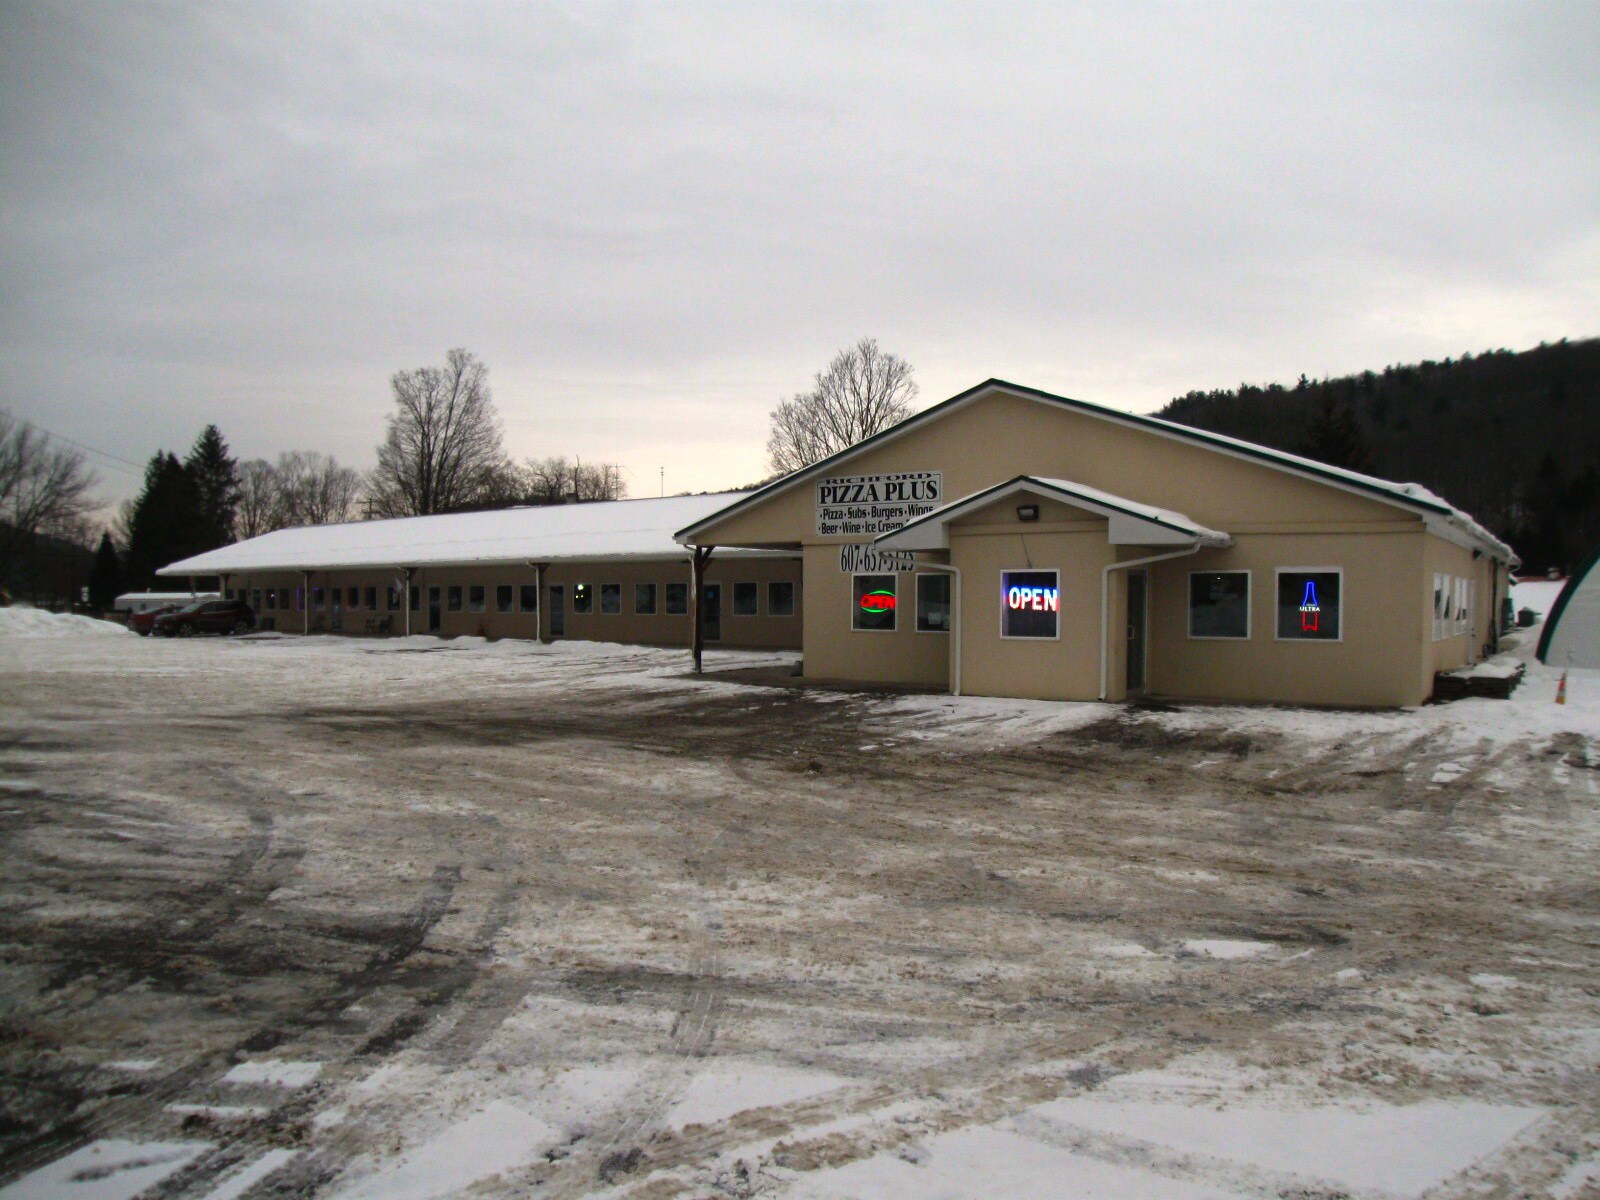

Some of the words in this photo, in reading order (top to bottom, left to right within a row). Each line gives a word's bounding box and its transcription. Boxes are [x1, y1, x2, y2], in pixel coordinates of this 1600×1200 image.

[825, 473, 932, 484] RICHFORD
[820, 484, 880, 504] PIZZA
[884, 480, 938, 501] PLUS
[823, 508, 843, 520] Pizza
[848, 507, 866, 519] Subs
[871, 506, 903, 520] Burgers
[821, 522, 838, 534] Beer
[842, 521, 860, 534] Wine
[865, 521, 876, 533] Ice
[878, 520, 903, 533] Cream
[1008, 586, 1059, 612] OPEN
